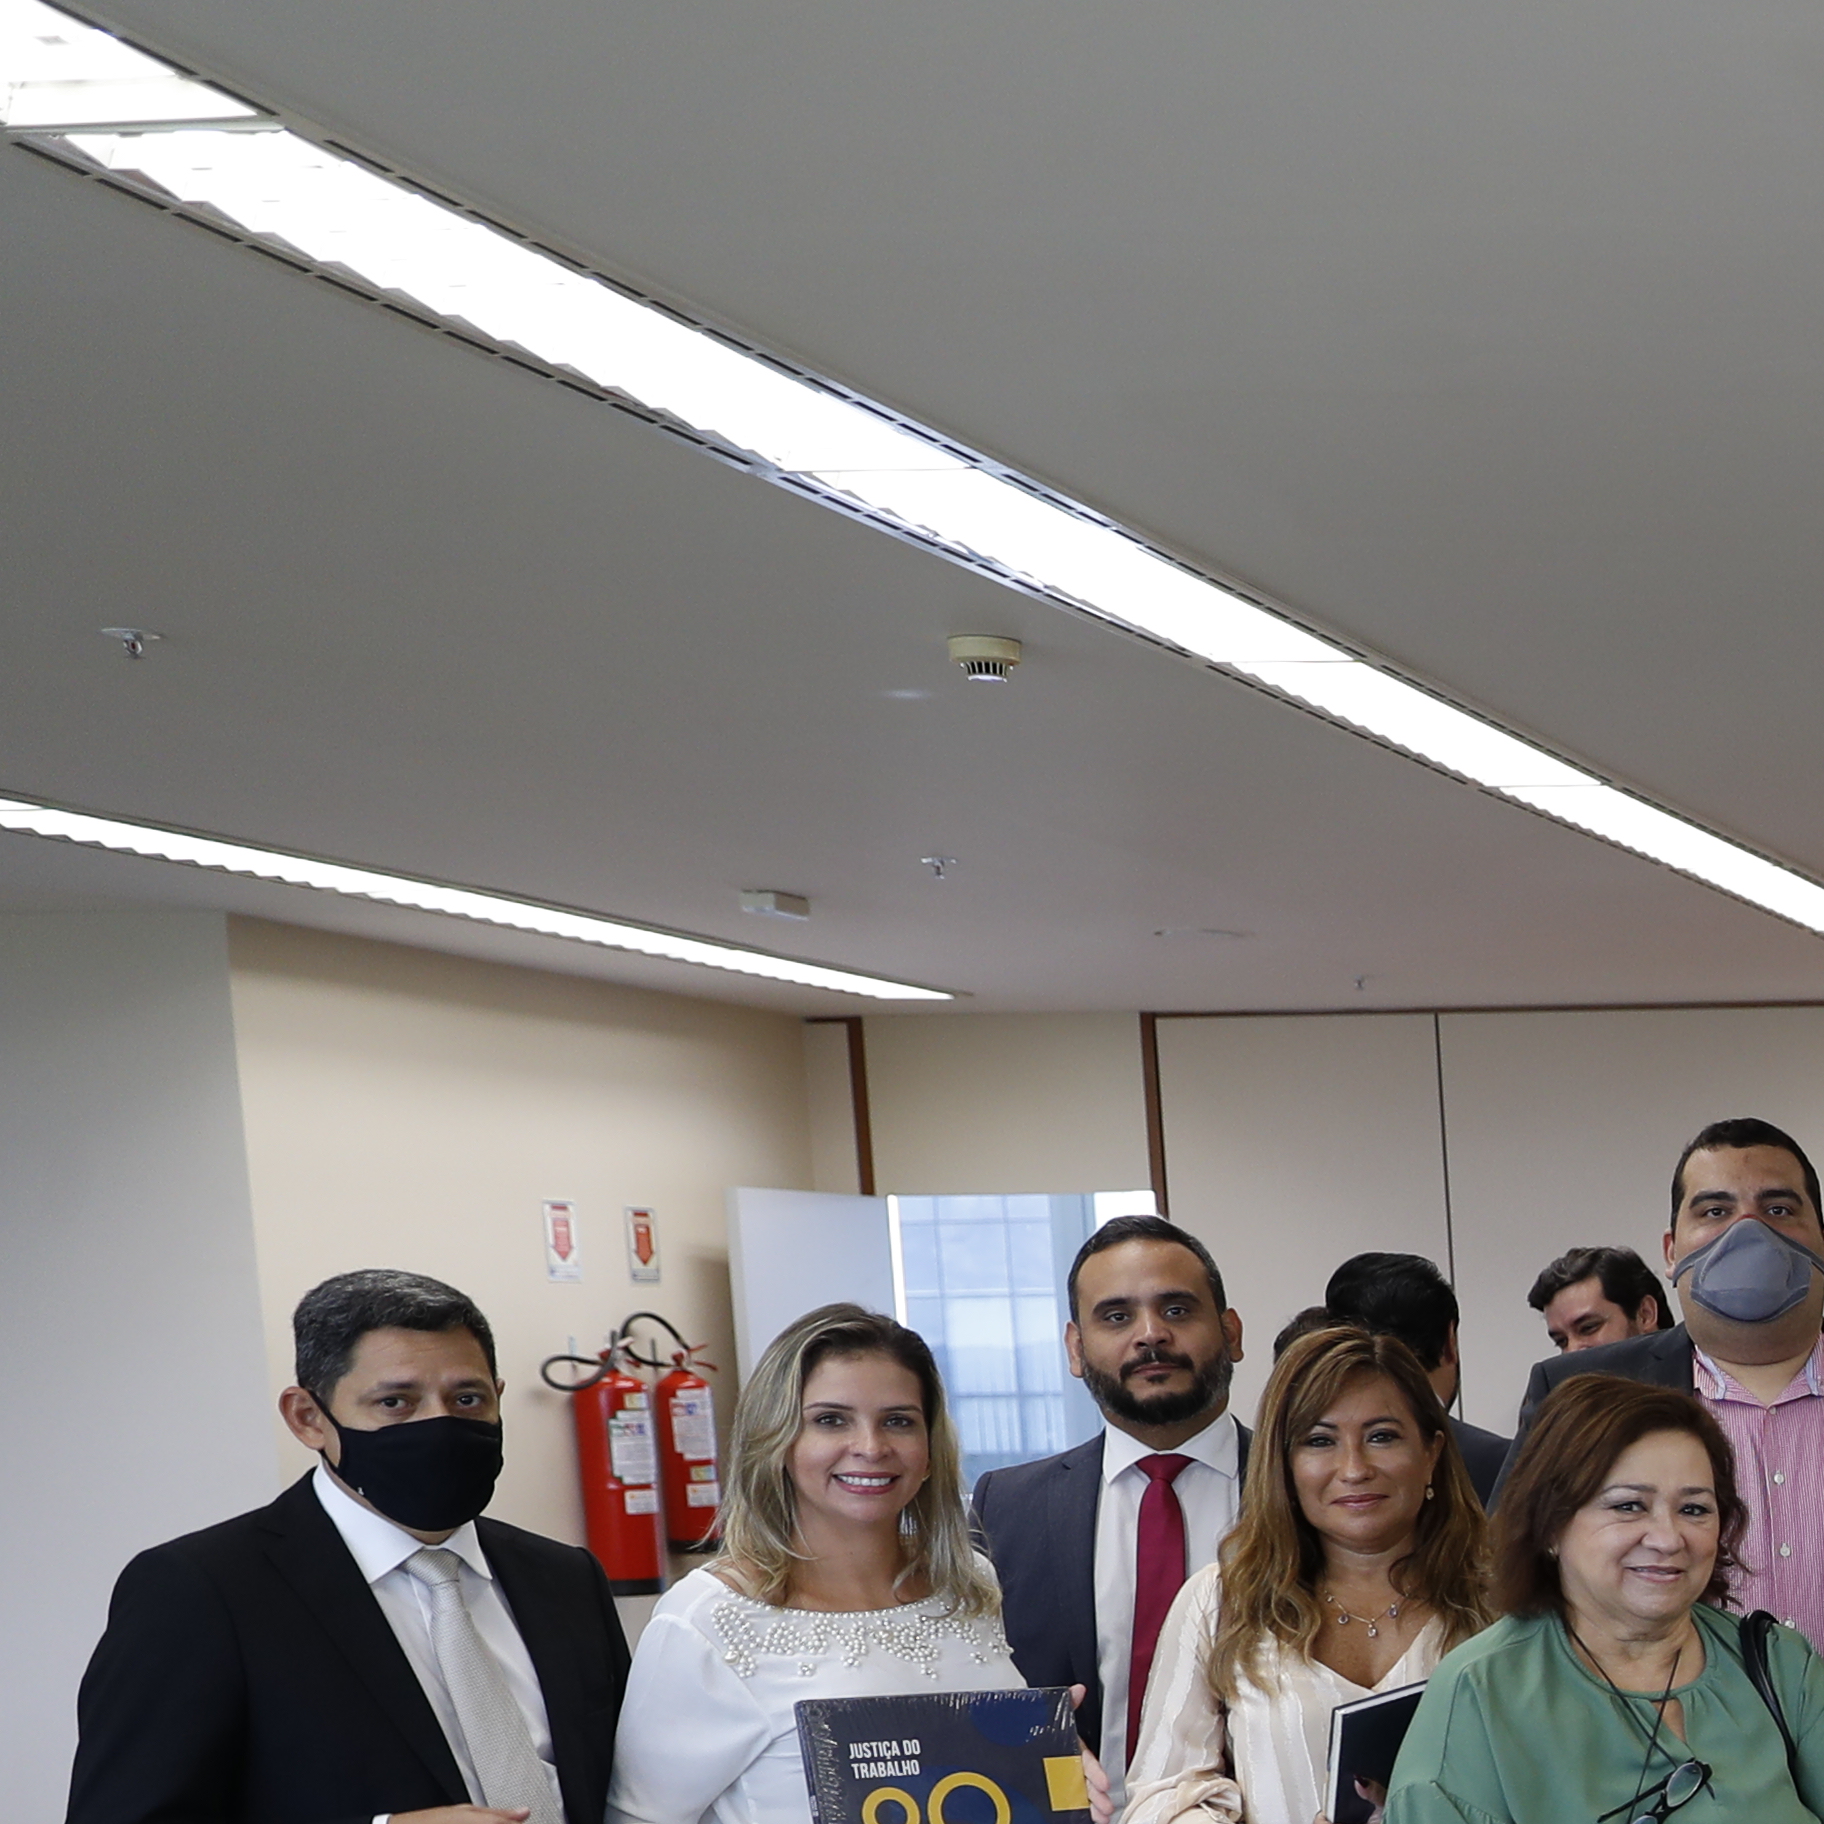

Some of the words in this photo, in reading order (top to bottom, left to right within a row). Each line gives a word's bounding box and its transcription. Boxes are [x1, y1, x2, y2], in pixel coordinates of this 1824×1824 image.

[849, 1740, 901, 1760] JUSTIÇA
[902, 1739, 921, 1756] DO
[851, 1759, 920, 1779] TRABALHO
